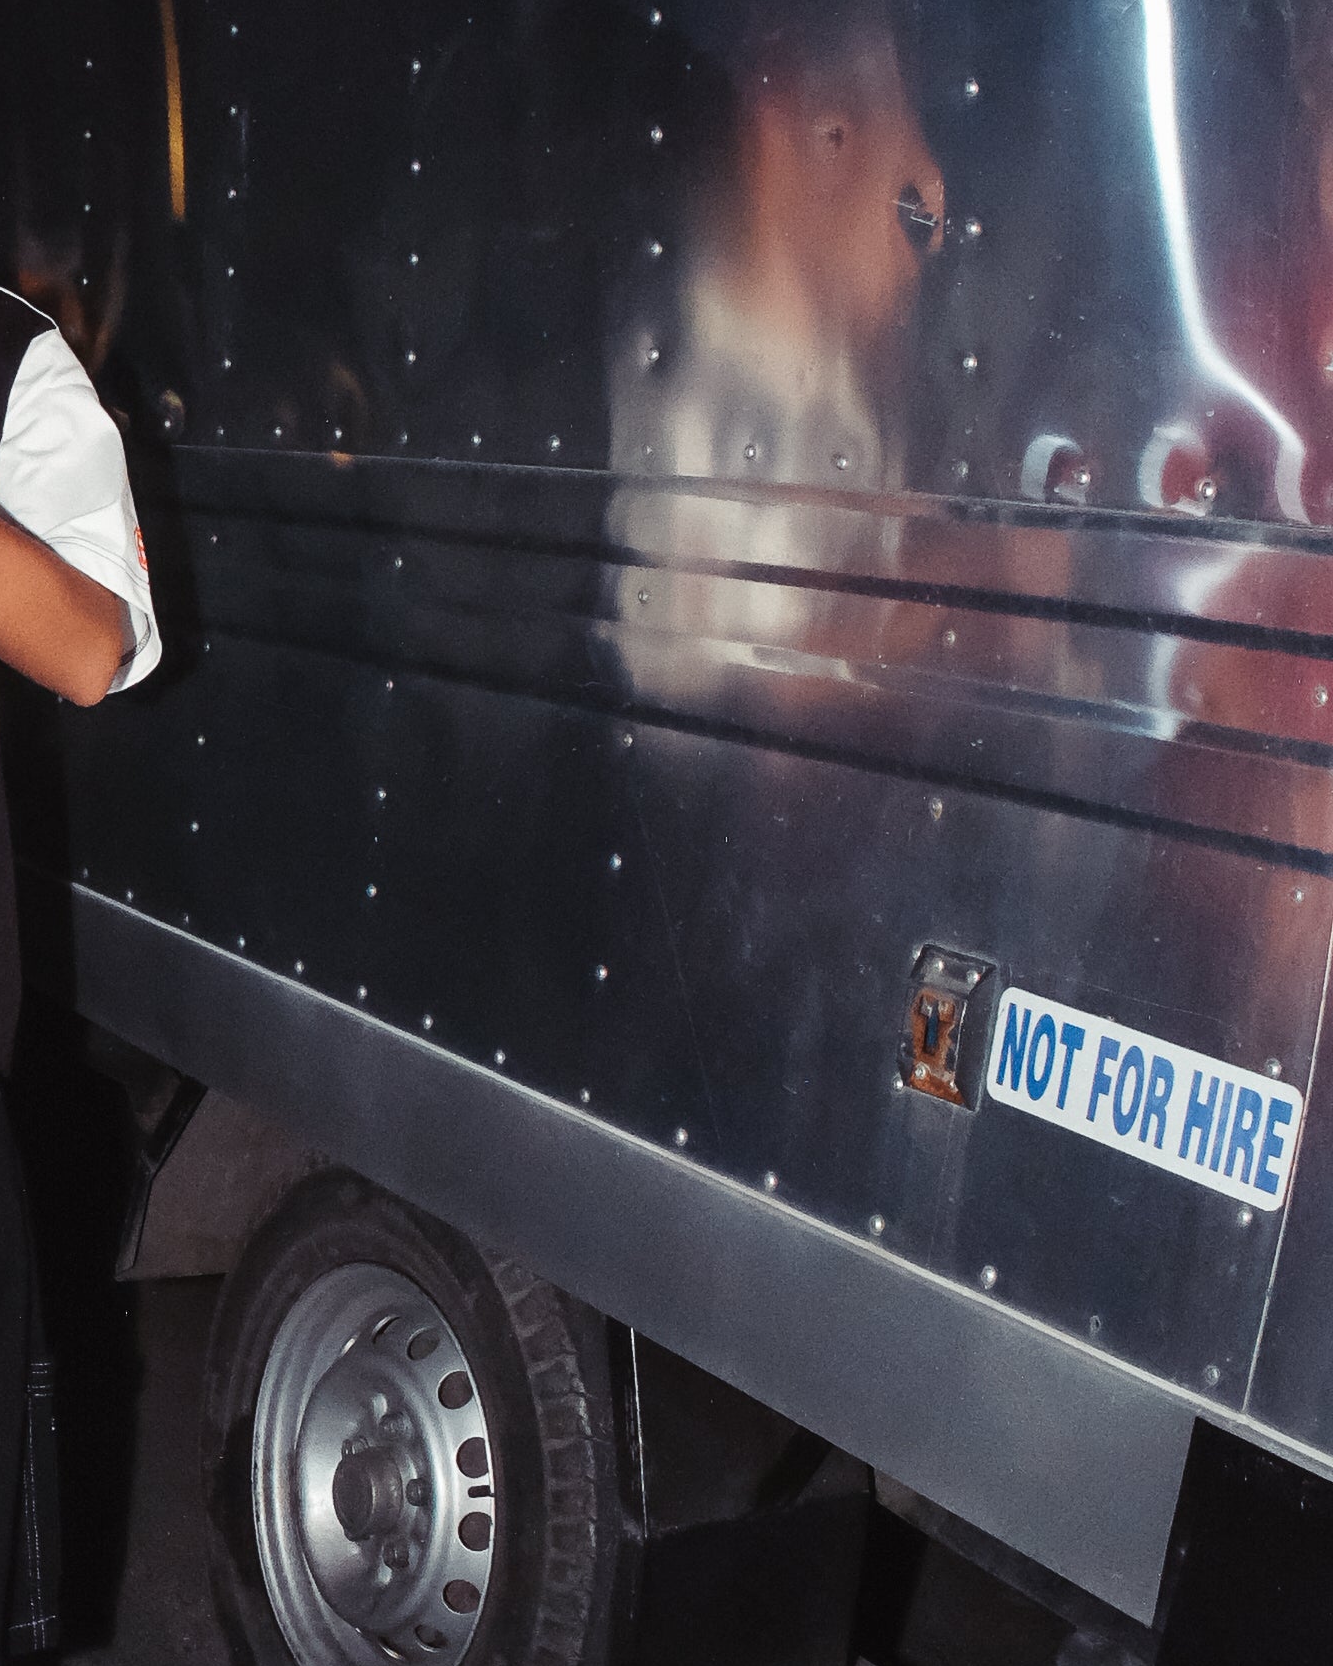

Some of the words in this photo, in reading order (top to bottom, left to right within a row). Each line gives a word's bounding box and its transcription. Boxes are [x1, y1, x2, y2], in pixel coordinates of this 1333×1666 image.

[995, 1002, 1085, 1111] NOT
[1086, 1035, 1175, 1150] FOR
[1178, 1070, 1294, 1196] HIRE
